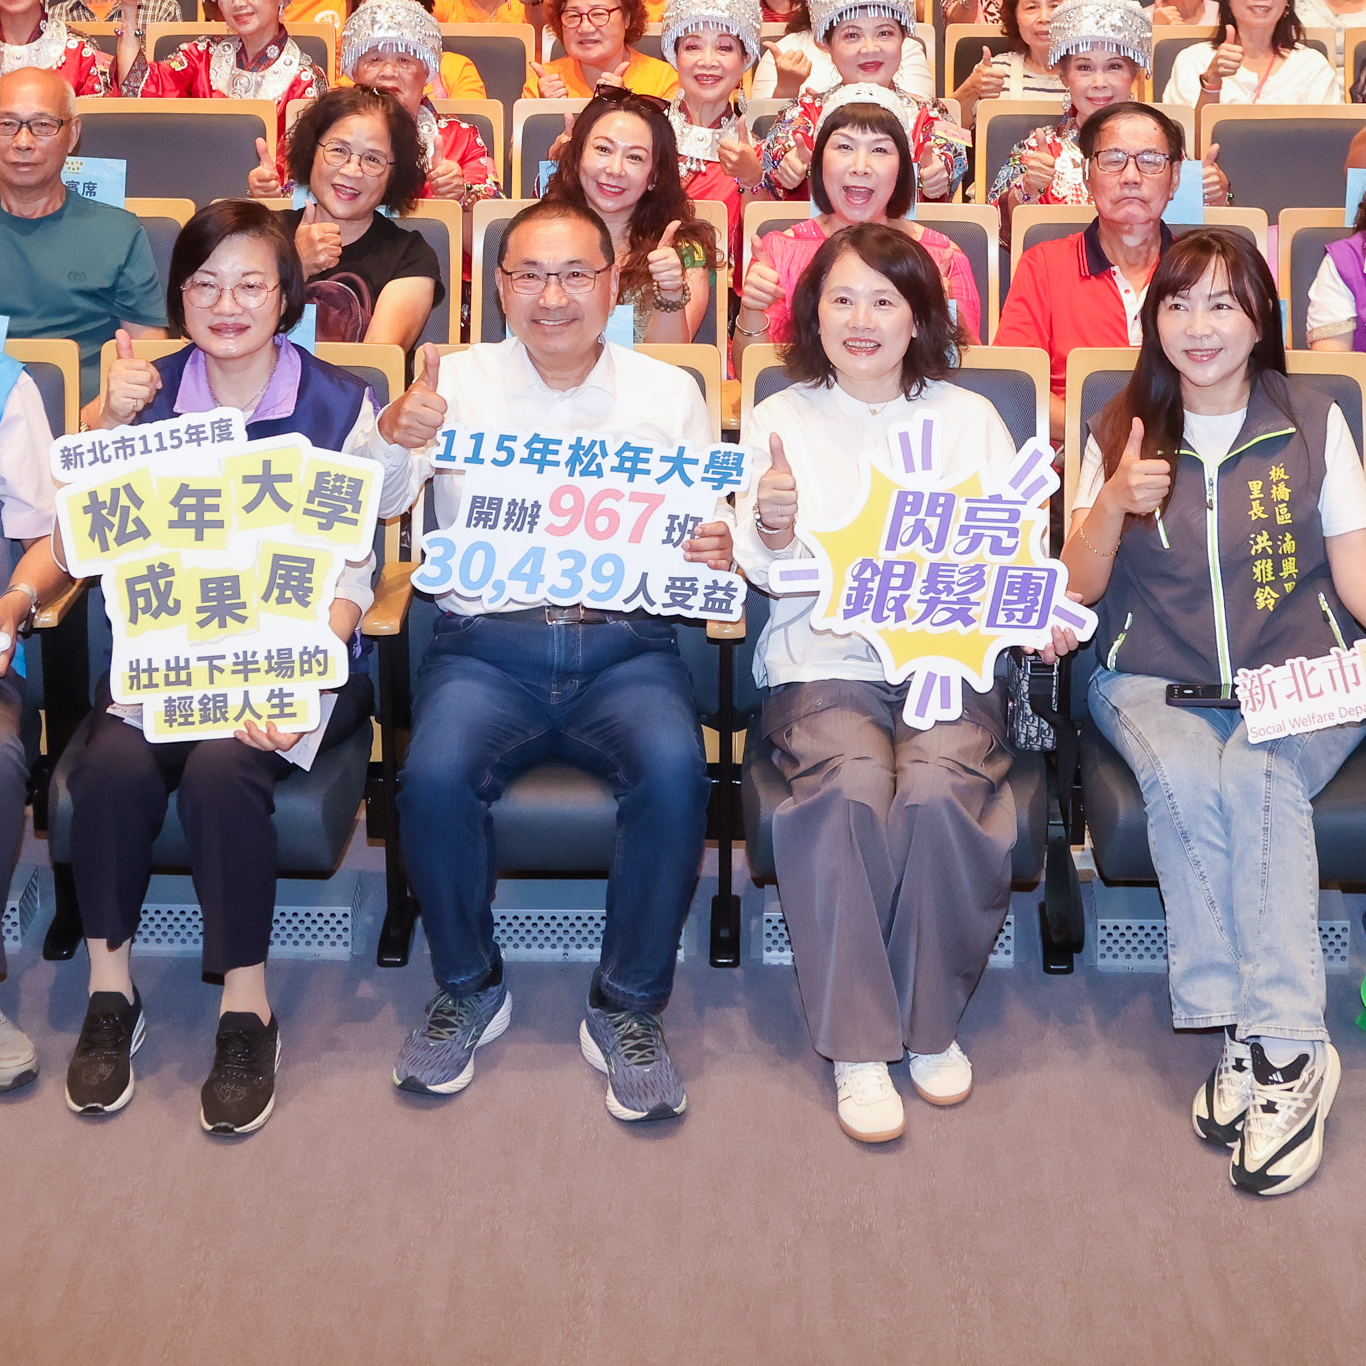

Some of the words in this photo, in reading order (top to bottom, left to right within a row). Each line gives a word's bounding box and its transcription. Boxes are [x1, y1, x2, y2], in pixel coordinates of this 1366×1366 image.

[60, 418, 235, 471] 新北市115年度
[435, 429, 745, 491] 115年松年大學
[82, 459, 365, 553] 松年大學
[885, 491, 1027, 556] 閃亮
[1247, 480, 1269, 521] 里長
[1269, 462, 1293, 525] 板橋區
[125, 553, 316, 629] 成果展
[416, 537, 738, 614] 30,439人受益
[843, 558, 1058, 629] 銀髮團
[1248, 530, 1281, 612] 洪雅鈴
[128, 645, 329, 692] 壯出下半場的
[163, 688, 297, 729] 輕銀人生
[1250, 720, 1286, 739] Social
[1289, 711, 1336, 732] Welfare
